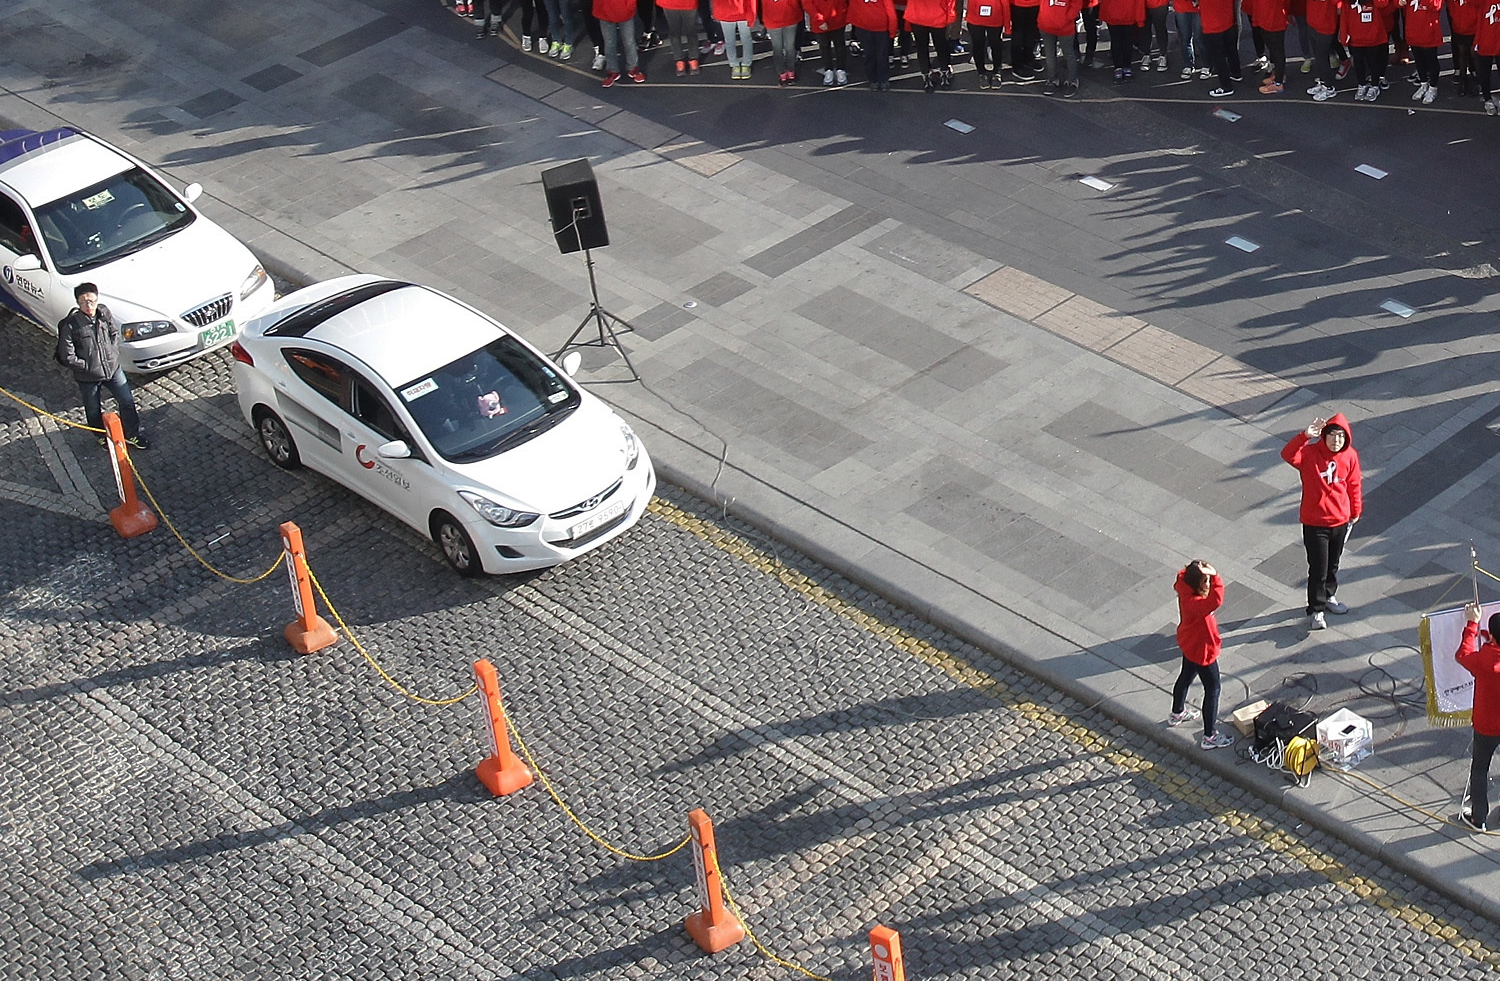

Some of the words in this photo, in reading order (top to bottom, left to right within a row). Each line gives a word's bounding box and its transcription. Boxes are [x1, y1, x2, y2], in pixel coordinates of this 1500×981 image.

[16, 274, 45, 299] 연합뉴스
[205, 324, 233, 346] 6221
[597, 505, 619, 522] 9590
